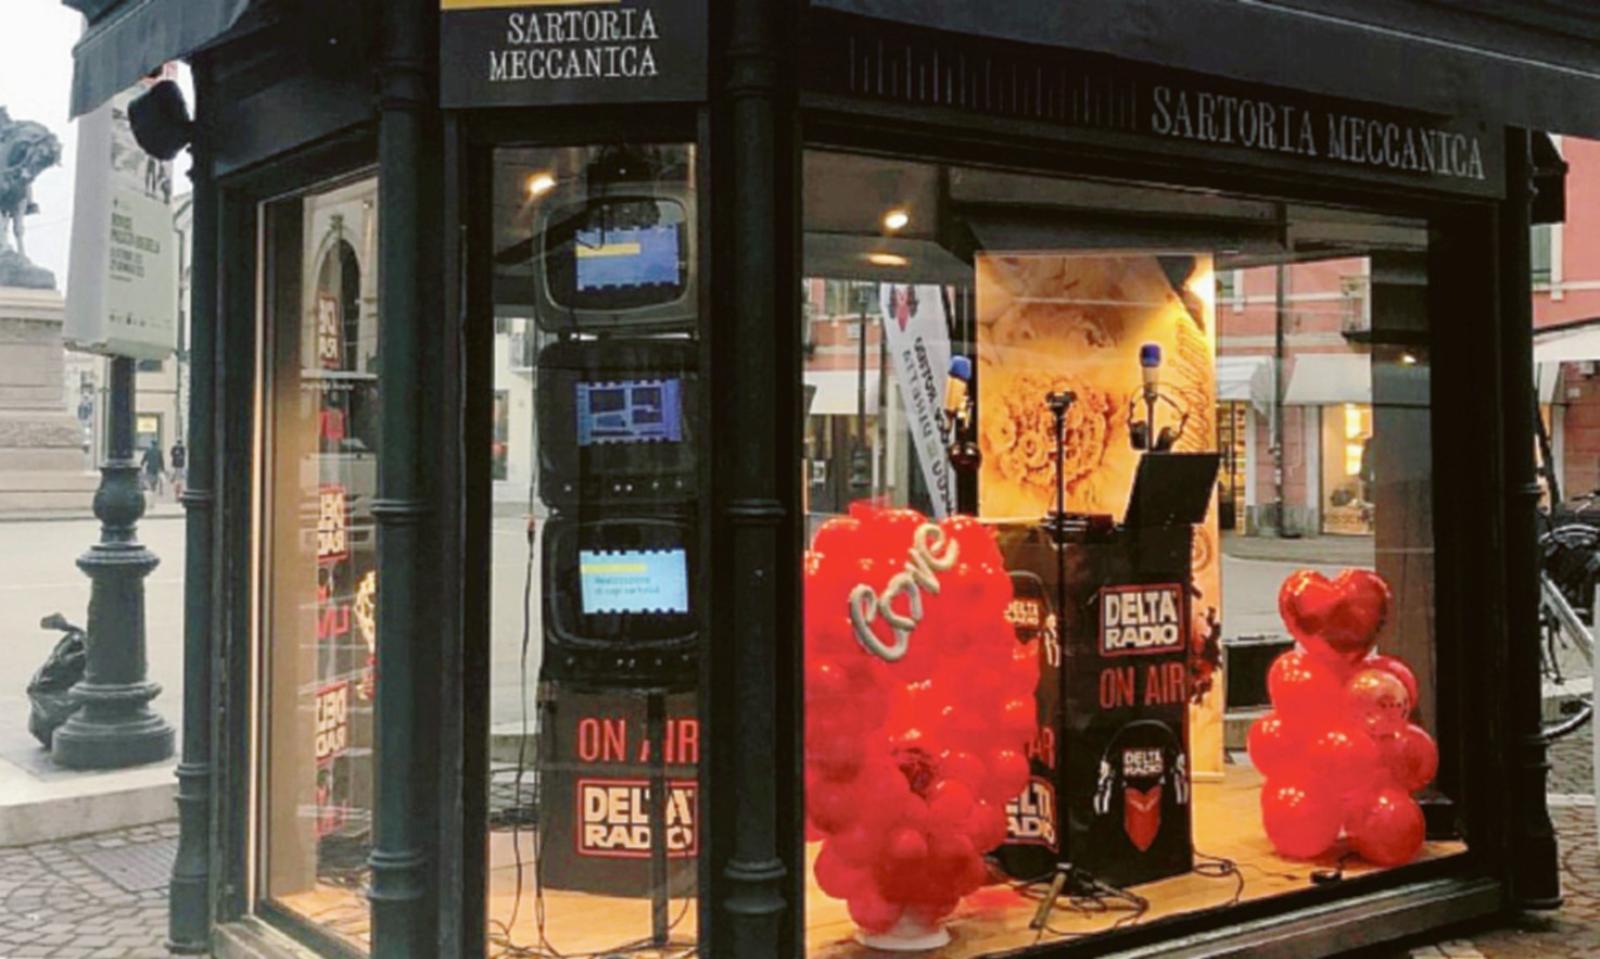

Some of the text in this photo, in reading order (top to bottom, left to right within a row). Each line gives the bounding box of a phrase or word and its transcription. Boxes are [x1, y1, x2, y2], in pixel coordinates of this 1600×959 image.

[507, 8, 659, 44] SARTORIA
[489, 45, 659, 81] MECCANICA
[1151, 86, 1486, 180] SARTORIA MECCANICA
[1105, 589, 1178, 627] DELTA
[1105, 623, 1178, 650] RADIO
[1100, 661, 1185, 708] ON AIR
[579, 717, 698, 764] ON IR
[584, 786, 693, 826] DELA
[585, 824, 693, 849] RADO
